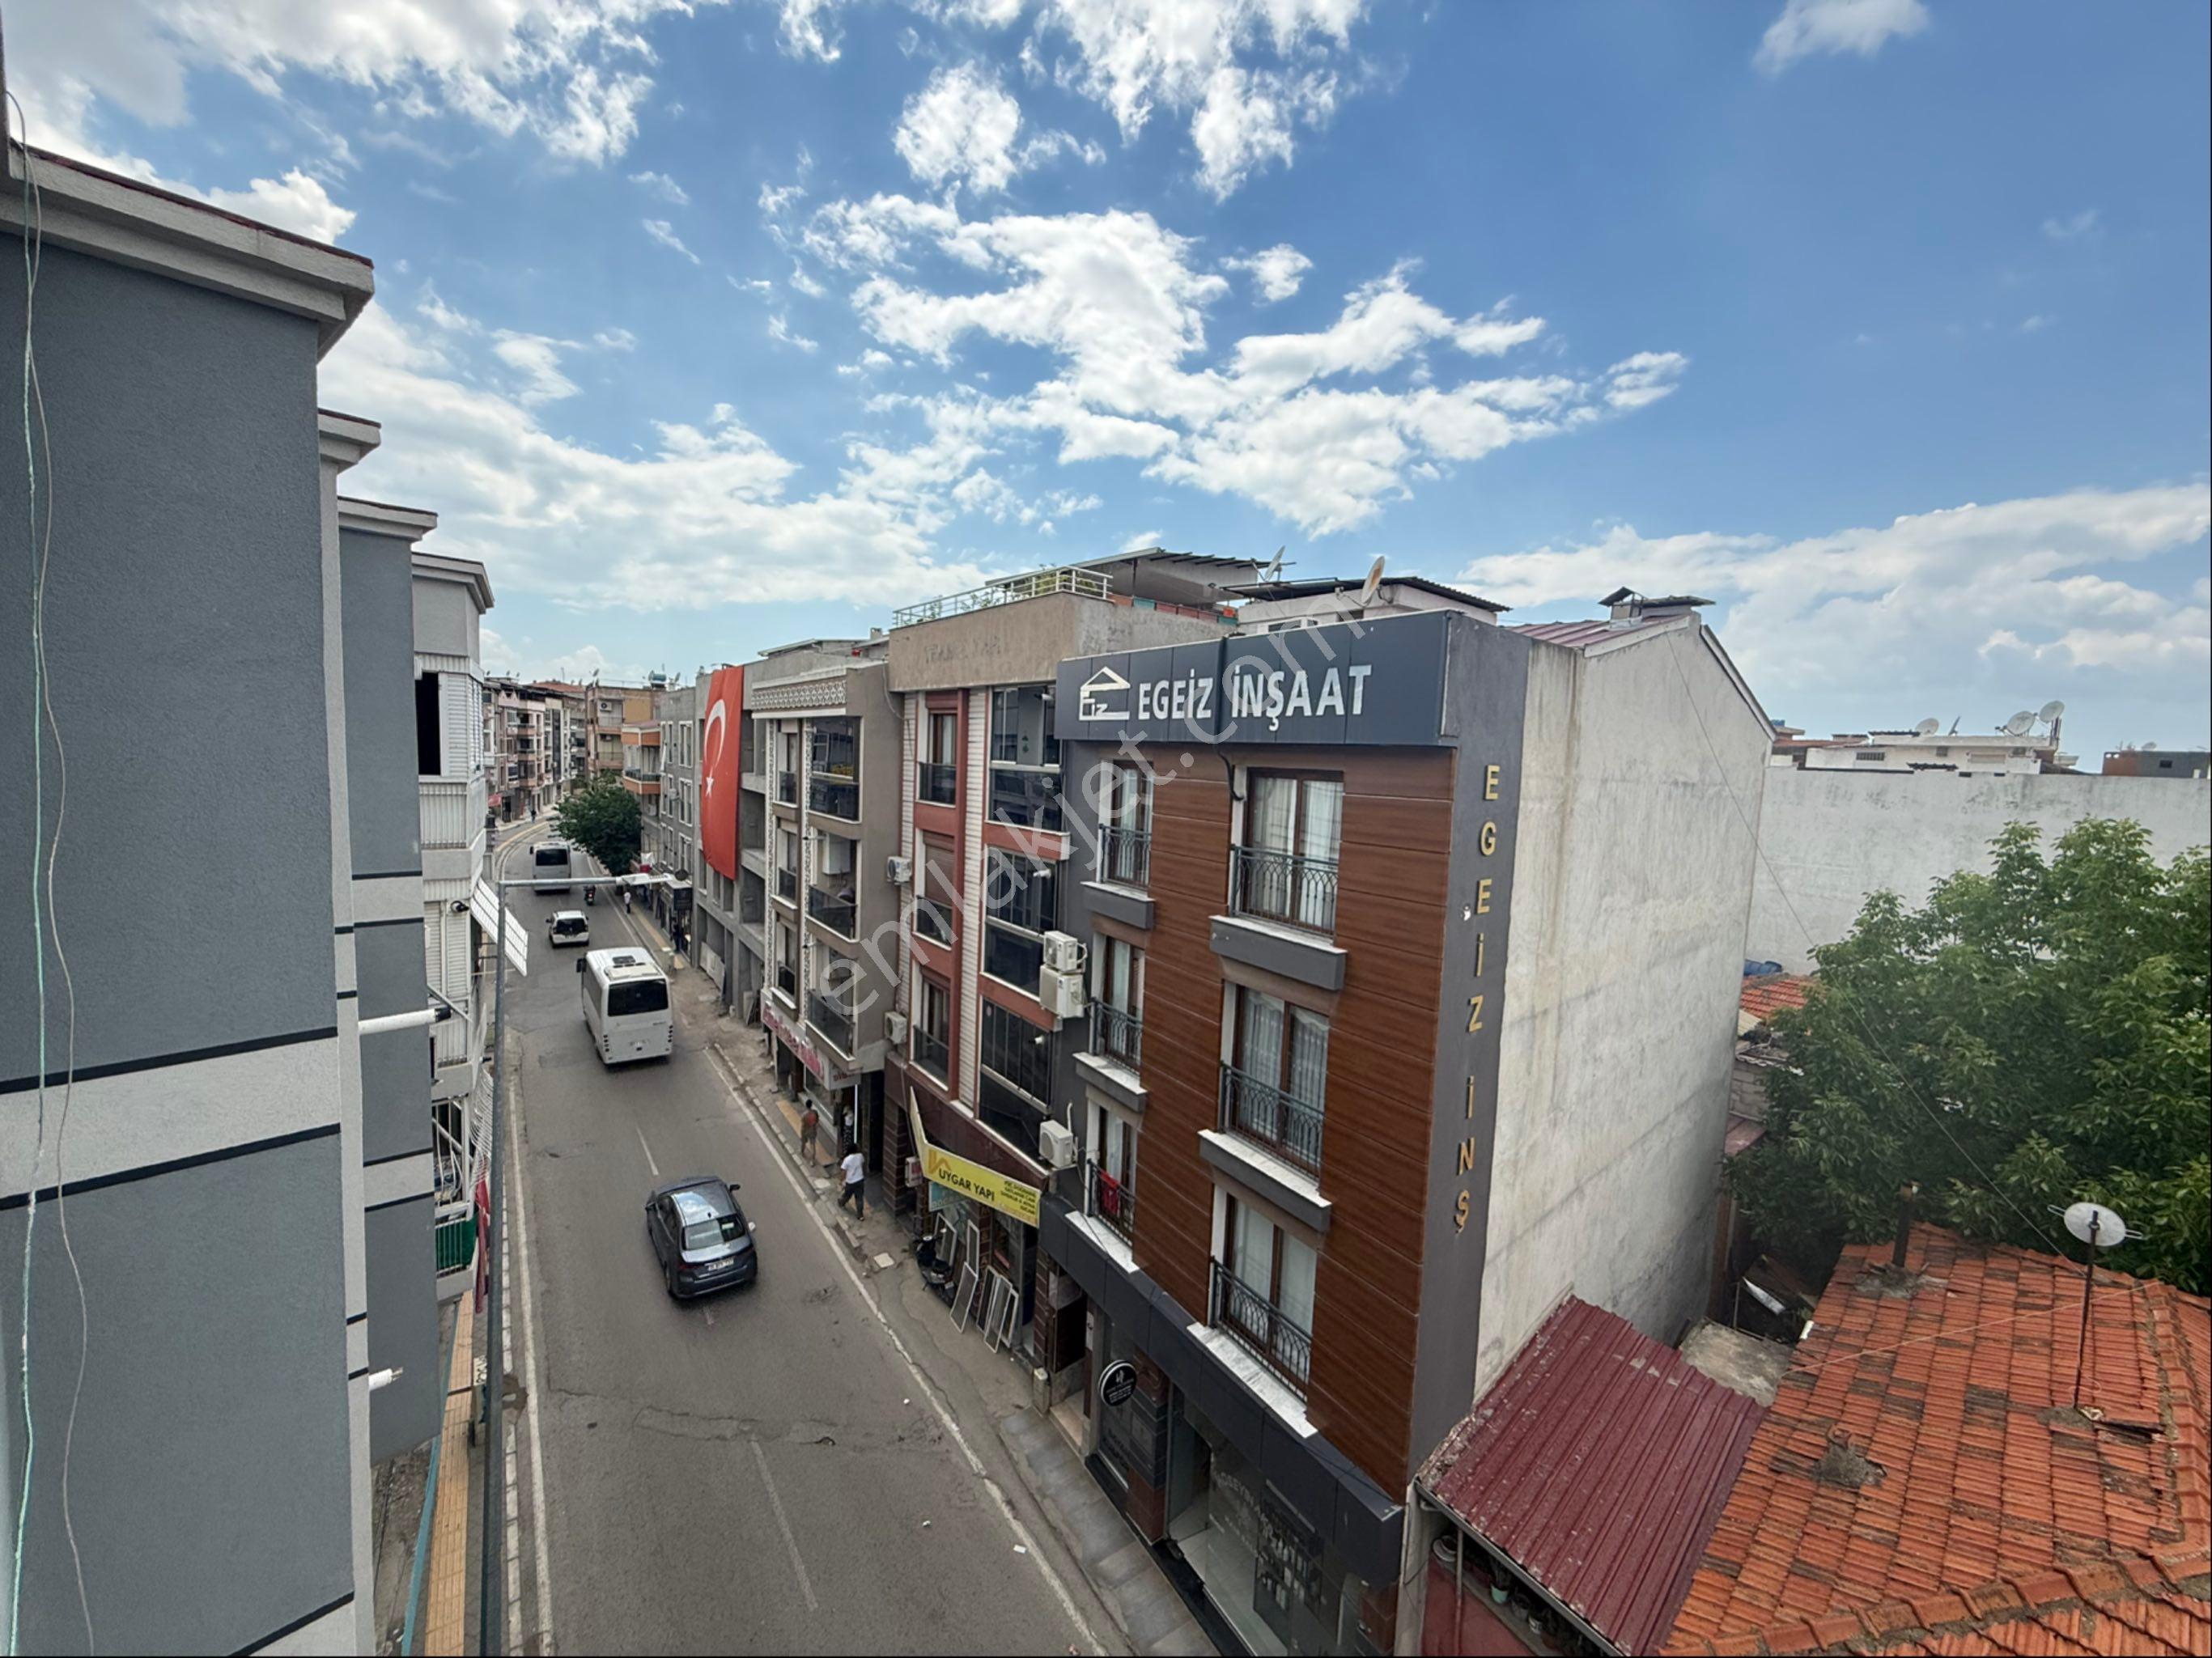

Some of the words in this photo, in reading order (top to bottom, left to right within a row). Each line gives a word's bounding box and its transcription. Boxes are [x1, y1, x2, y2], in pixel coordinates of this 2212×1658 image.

[1138, 668, 1213, 720] EGEİZ
[1231, 664, 1372, 731] İNŞAAT
[939, 1168, 971, 1191] UYGAR
[974, 1184, 996, 1202] YAPI
